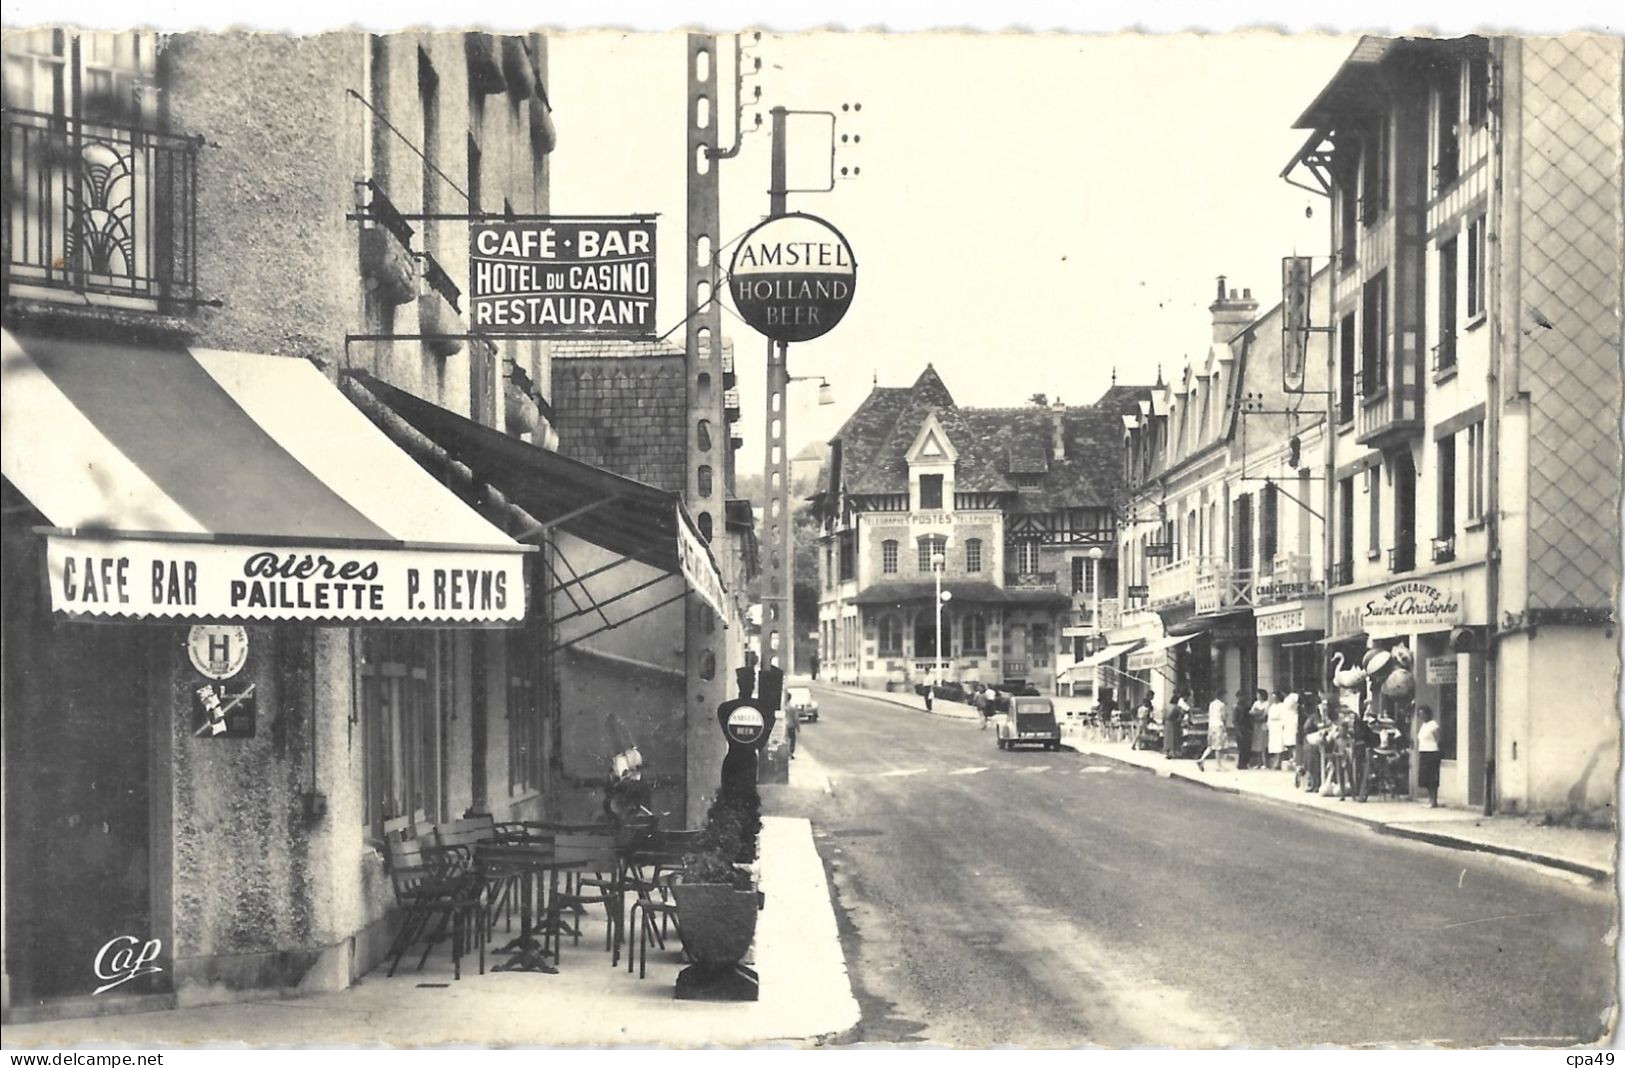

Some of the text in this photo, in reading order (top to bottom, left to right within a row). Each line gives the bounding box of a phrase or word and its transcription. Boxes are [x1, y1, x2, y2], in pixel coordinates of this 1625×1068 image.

[477, 228, 650, 258] CAFÉ BAR
[740, 243, 848, 267] AMSTEL
[477, 262, 649, 294] HOTEL DU CASINO
[740, 280, 848, 300] HOLLAND
[477, 298, 649, 325] RESTAURANT
[767, 306, 819, 325] BEER
[912, 514, 952, 525] POSTES
[244, 552, 378, 581] Bières
[152, 560, 197, 605] BAR
[231, 580, 384, 611] PAILLETTE
[407, 568, 507, 610] P. REYNS
[1365, 596, 1458, 618] Saint Christophe
[209, 634, 229, 661] H
